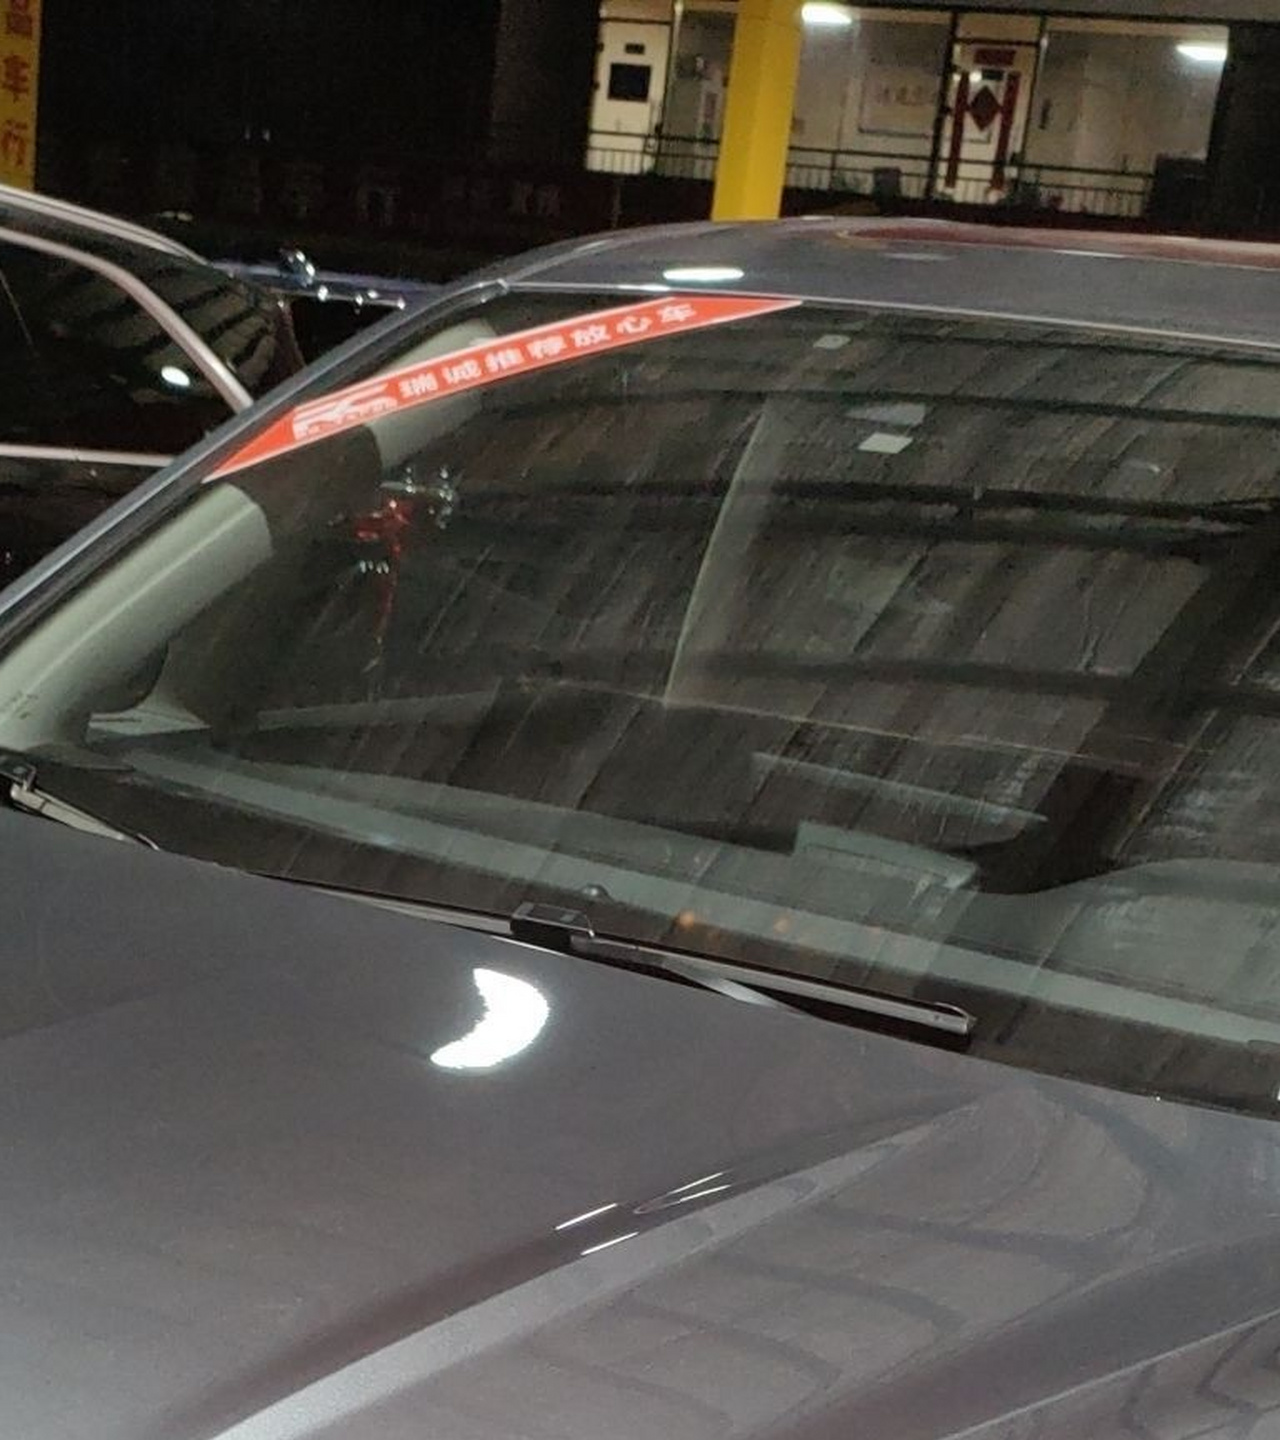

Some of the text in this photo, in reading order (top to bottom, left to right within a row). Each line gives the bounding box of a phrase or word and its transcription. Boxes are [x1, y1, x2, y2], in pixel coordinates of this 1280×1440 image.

[401, 304, 696, 397] 瑞诚推荐放心车
